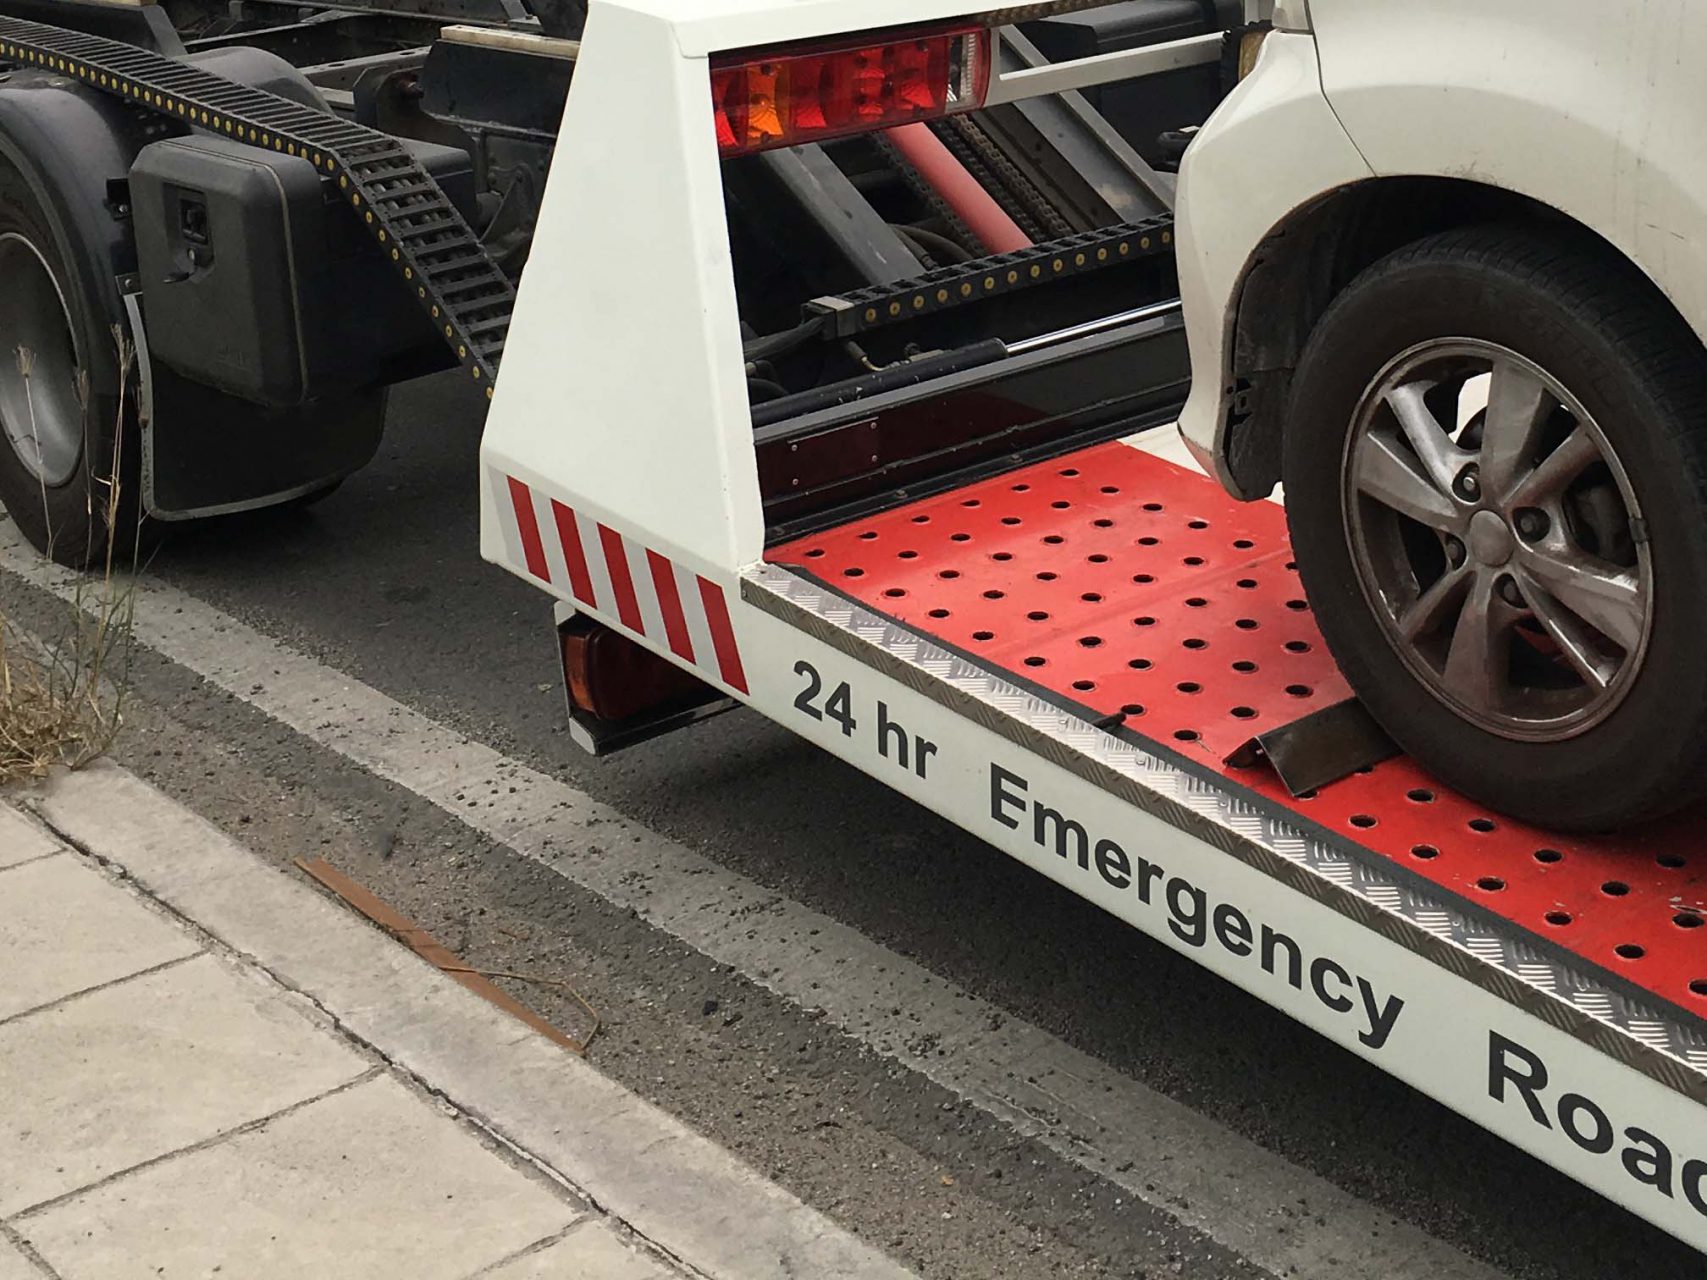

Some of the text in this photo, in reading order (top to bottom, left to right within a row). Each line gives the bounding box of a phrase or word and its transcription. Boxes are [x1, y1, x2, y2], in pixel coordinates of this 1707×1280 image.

[793, 660, 857, 738] 24
[877, 700, 938, 780] hr
[990, 762, 1405, 1050] Emergency
